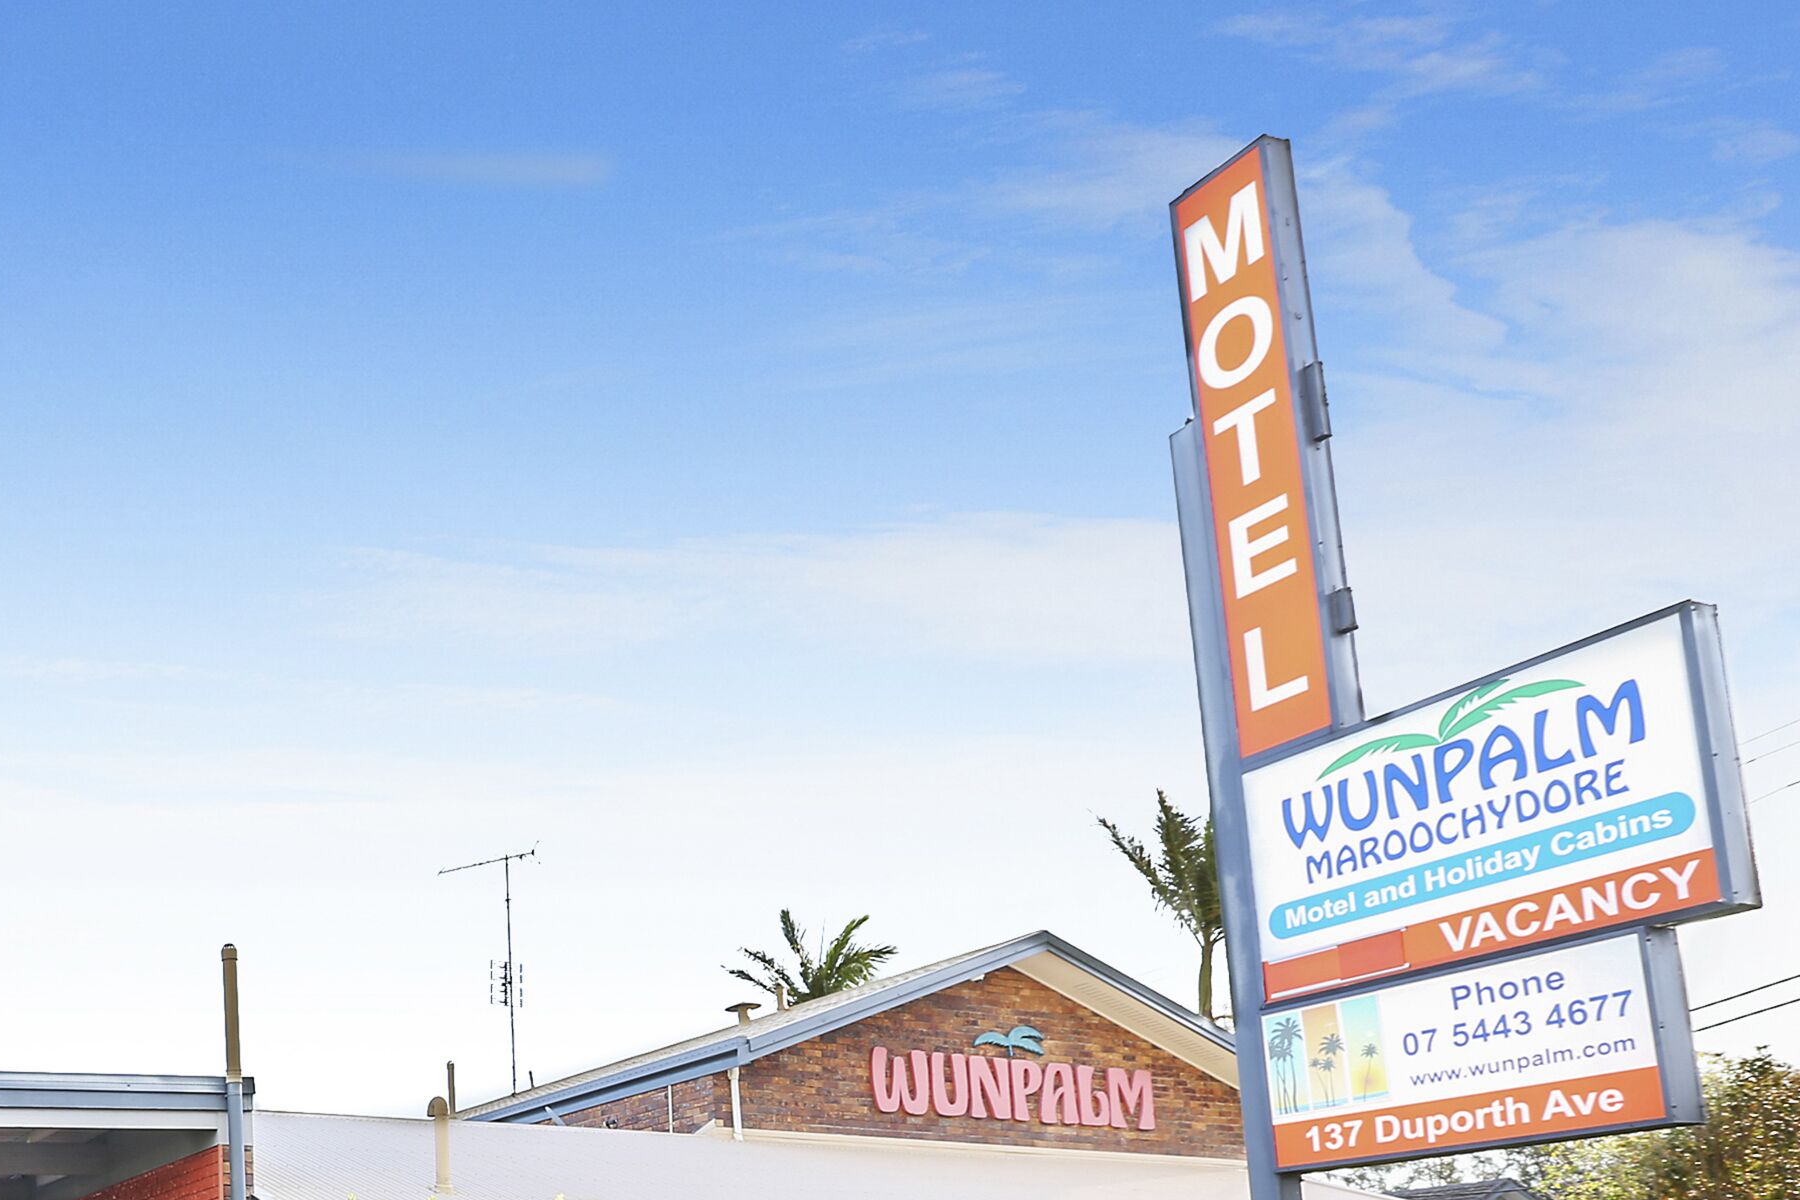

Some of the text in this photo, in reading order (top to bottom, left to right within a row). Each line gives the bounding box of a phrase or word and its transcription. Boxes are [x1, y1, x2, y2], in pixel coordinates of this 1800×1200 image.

[1184, 181, 1309, 712] MOTEL
[1282, 679, 1646, 850] WUNPALM
[1306, 759, 1630, 884] MAROOCHYDORE
[1285, 807, 1674, 929] Motel and Holiday Cabins
[1440, 860, 1701, 952] VACANCY
[1403, 989, 1633, 1056] 07 5443 4677
[1451, 970, 1565, 1010] Phone
[871, 1046, 1156, 1130] WUNPALM
[1409, 1037, 1636, 1086] www.wunpalm.com
[1305, 1087, 1625, 1152] 137 Duporth Ave
